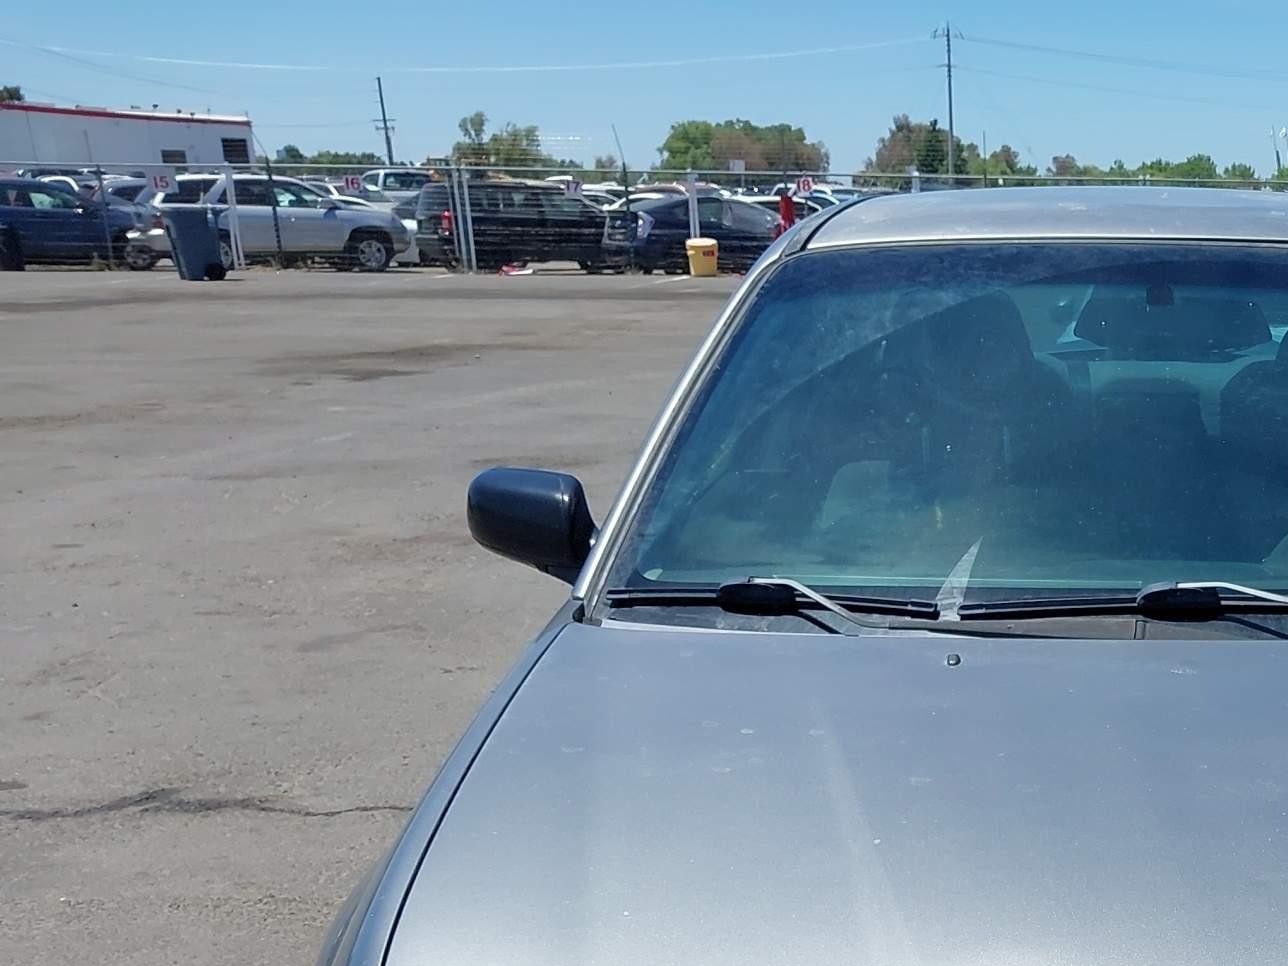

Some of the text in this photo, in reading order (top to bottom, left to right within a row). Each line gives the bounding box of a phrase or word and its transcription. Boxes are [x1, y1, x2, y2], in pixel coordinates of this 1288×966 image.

[153, 176, 170, 190] 15
[345, 177, 361, 190] 16
[797, 179, 811, 192] 18
